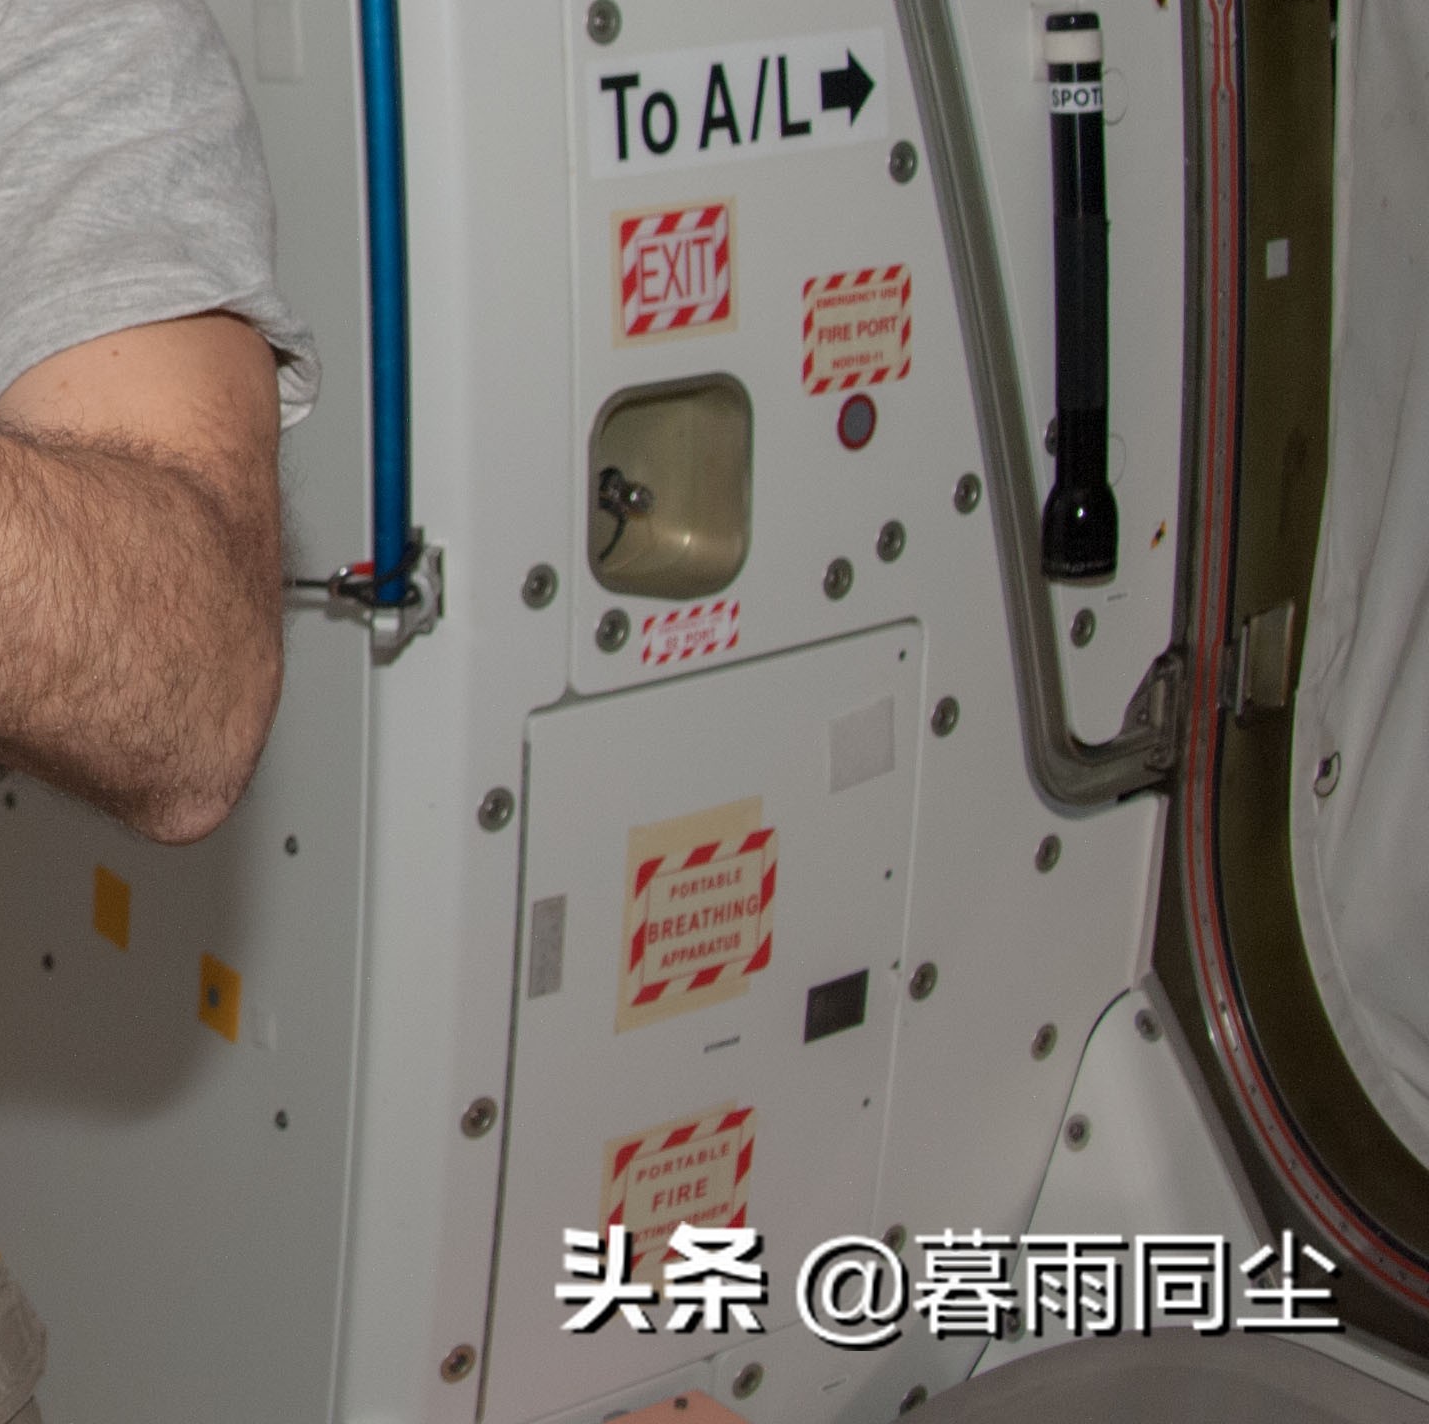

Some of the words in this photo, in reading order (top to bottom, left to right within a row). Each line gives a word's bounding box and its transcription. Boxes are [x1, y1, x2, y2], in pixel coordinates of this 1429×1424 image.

[600, 73, 679, 161] To
[699, 54, 812, 152] A/L
[640, 236, 713, 306] EXIT
[818, 323, 851, 344] FIRE
[856, 316, 898, 338] PORT
[670, 867, 741, 901] PORTABLE
[647, 893, 760, 944] BREATHING
[660, 932, 741, 970] APPARATUS
[636, 1140, 731, 1185] PORTABLE
[651, 1178, 708, 1213] FIRE
